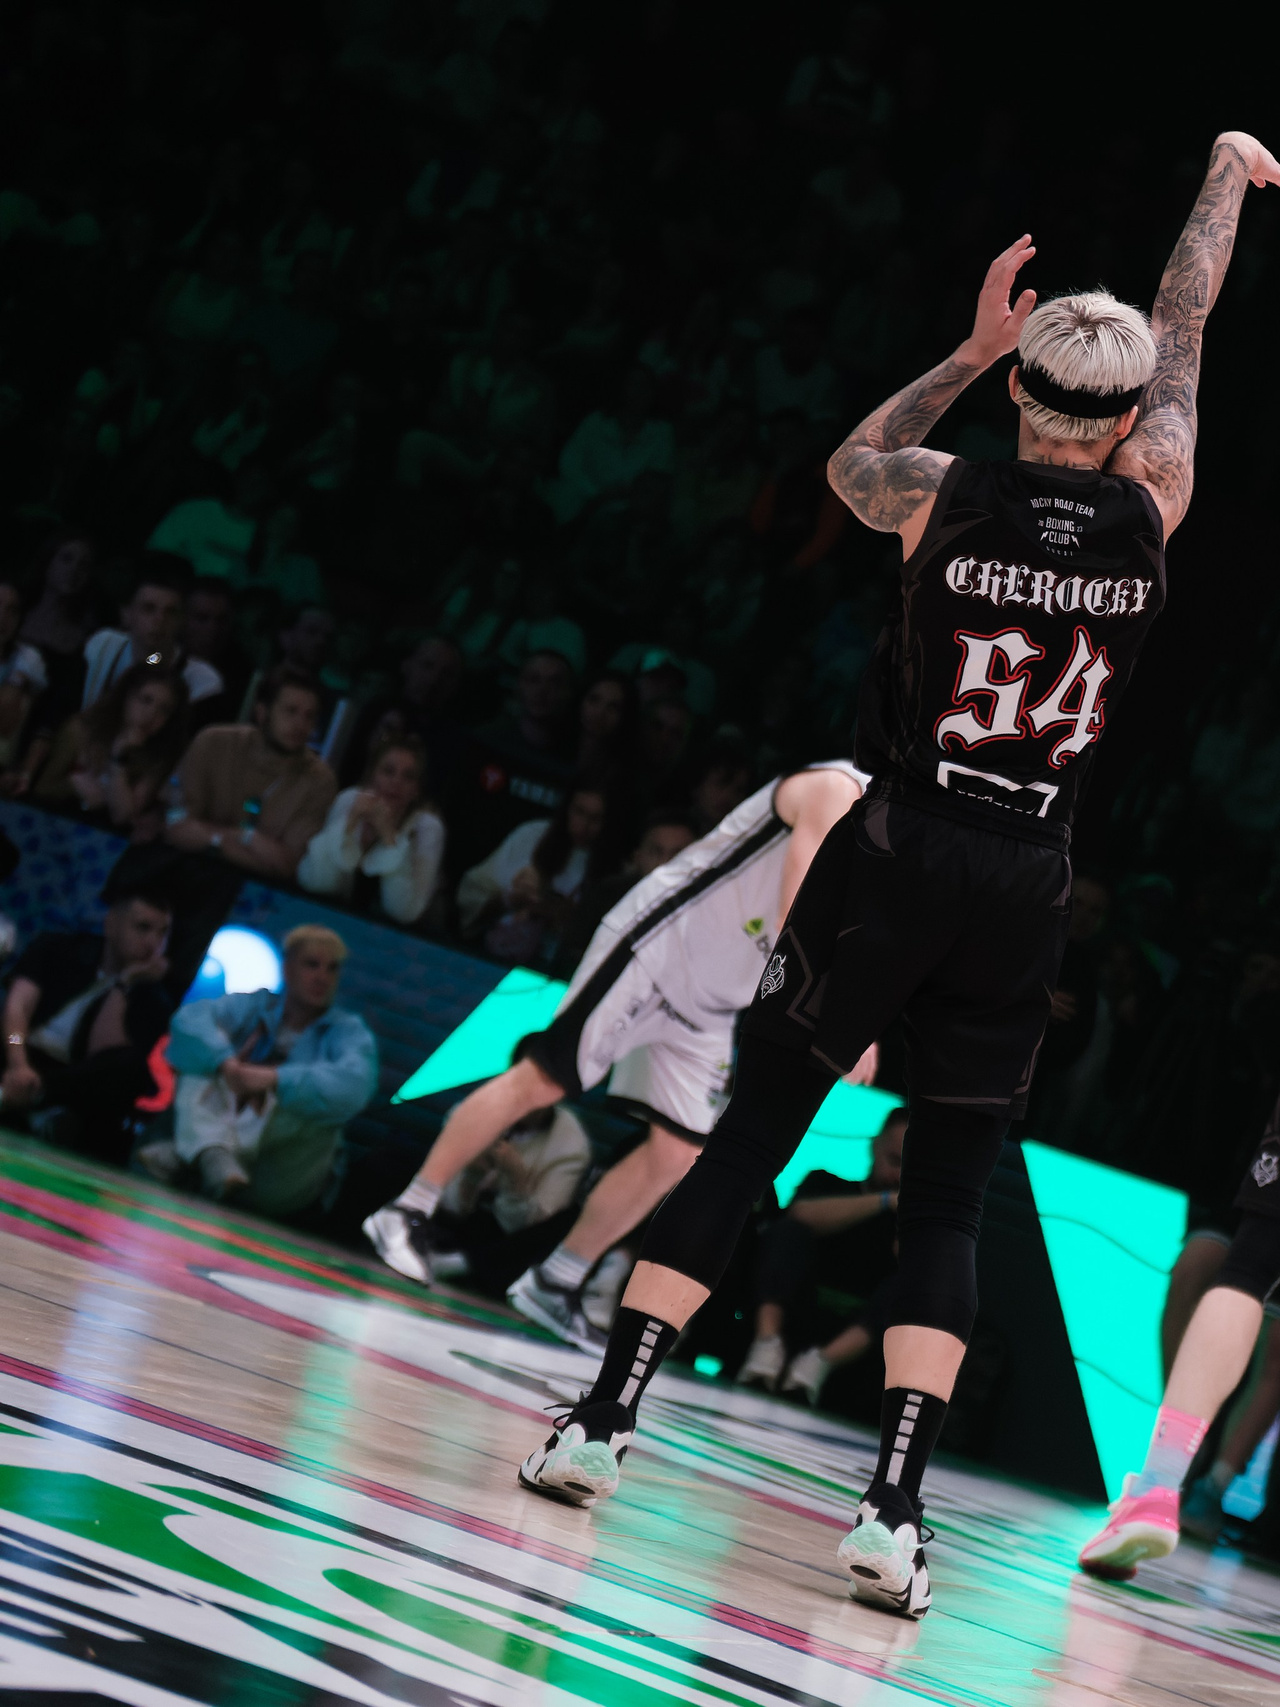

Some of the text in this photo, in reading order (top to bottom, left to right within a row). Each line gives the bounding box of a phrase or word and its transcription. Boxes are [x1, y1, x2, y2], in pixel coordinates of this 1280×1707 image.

[1054, 498, 1074, 511] ROAD
[1075, 503, 1095, 518] TEAM
[1045, 516, 1075, 532] BOXING
[1048, 531, 1070, 545] CLUB
[934, 626, 1114, 769] 54
